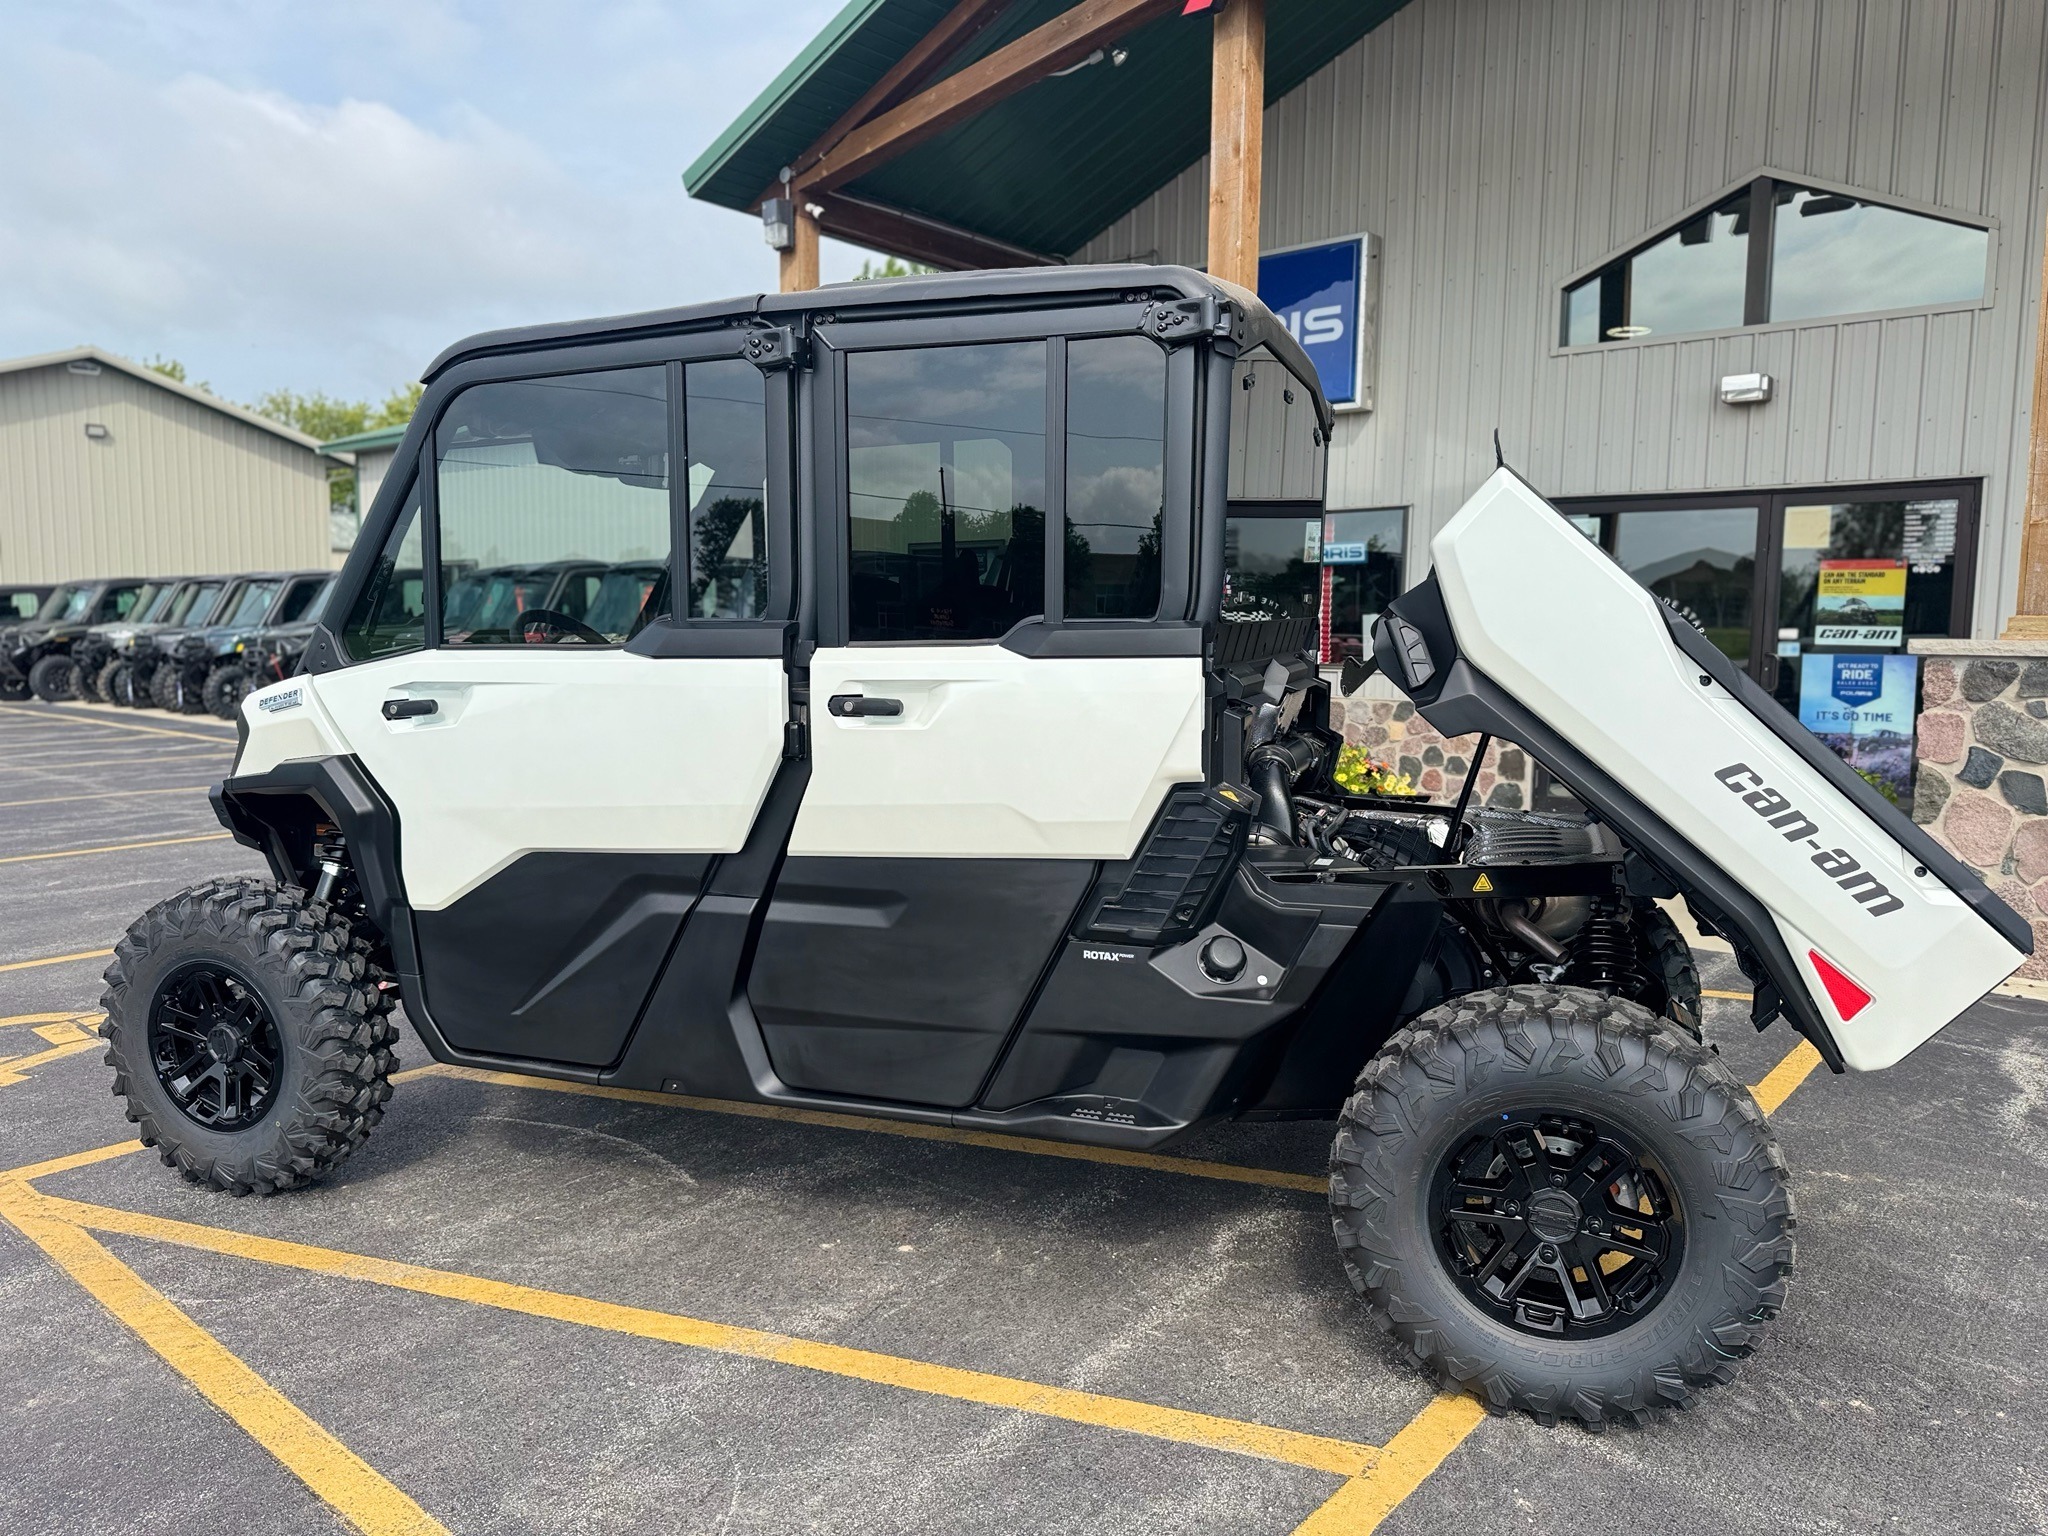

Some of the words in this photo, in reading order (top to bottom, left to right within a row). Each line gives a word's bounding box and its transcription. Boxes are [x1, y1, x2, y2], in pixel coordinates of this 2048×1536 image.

[1275, 304, 1344, 346] IS
[1818, 628, 1898, 640] can-am
[1841, 669, 1873, 681] RIDE
[259, 689, 299, 707] DEFENDER
[1816, 710, 1839, 720] IT'S
[1842, 711, 1860, 721] GO
[1862, 712, 1893, 723] TIME
[1714, 762, 1905, 918] can-am
[1083, 950, 1119, 962] ROTAX
